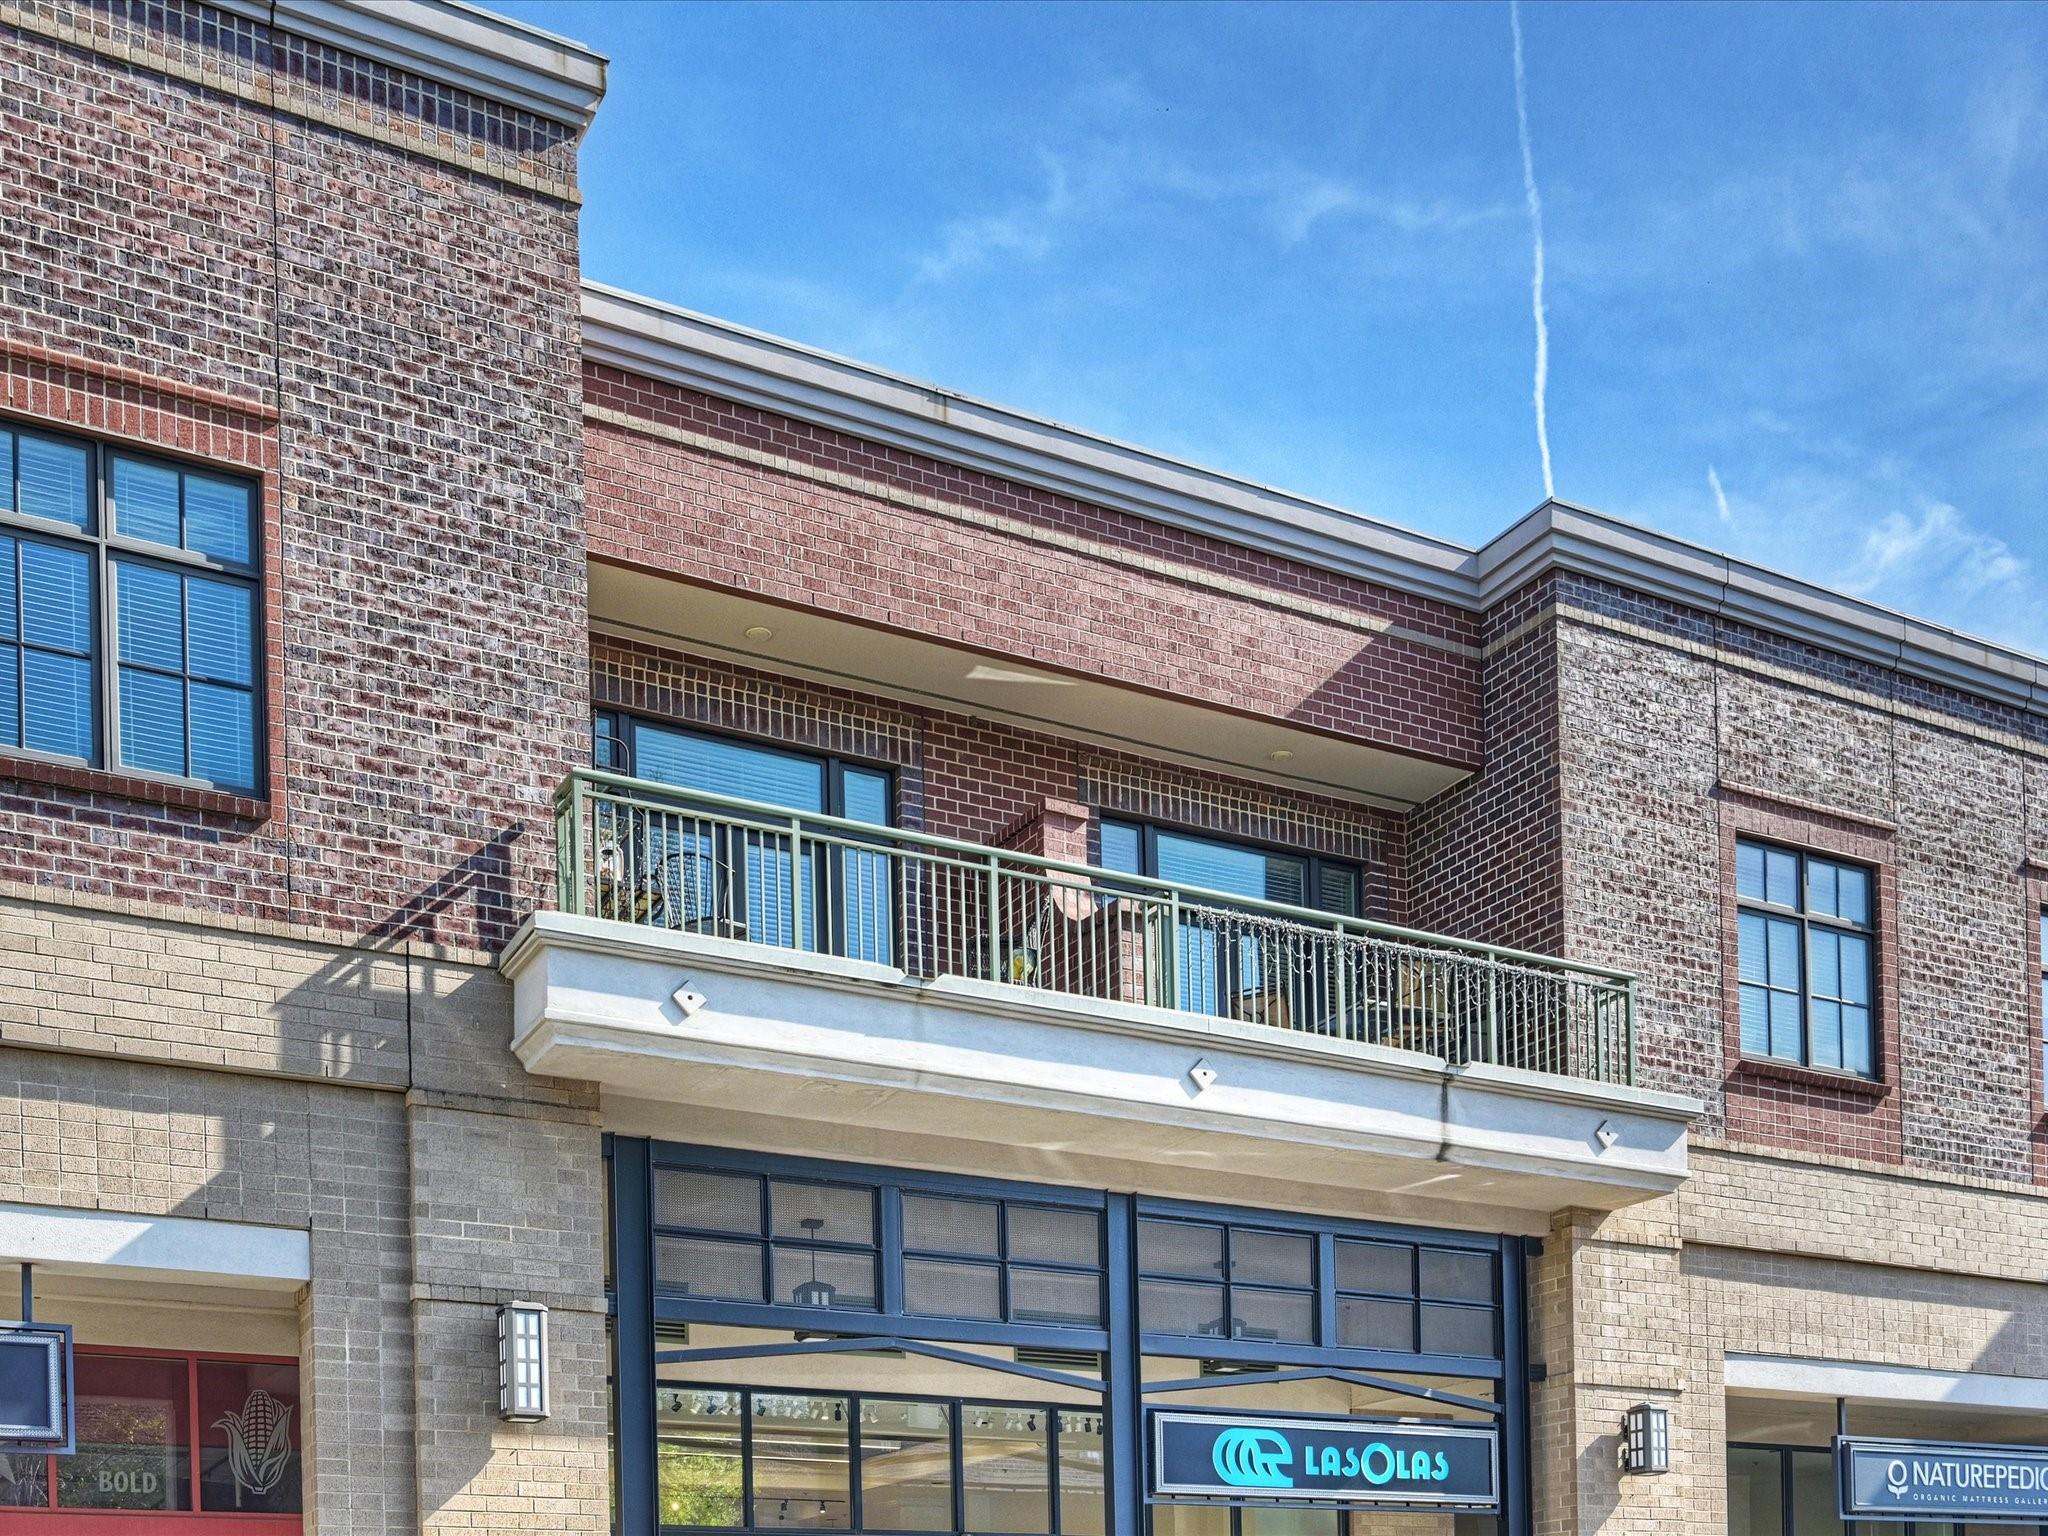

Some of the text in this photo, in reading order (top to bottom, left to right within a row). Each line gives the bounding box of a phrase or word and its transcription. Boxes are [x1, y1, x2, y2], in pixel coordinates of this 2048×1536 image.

[99, 1470, 157, 1494] BOLD
[1913, 1493, 1957, 1502] ORGANIC
[1962, 1495, 2009, 1504] MATTRESS
